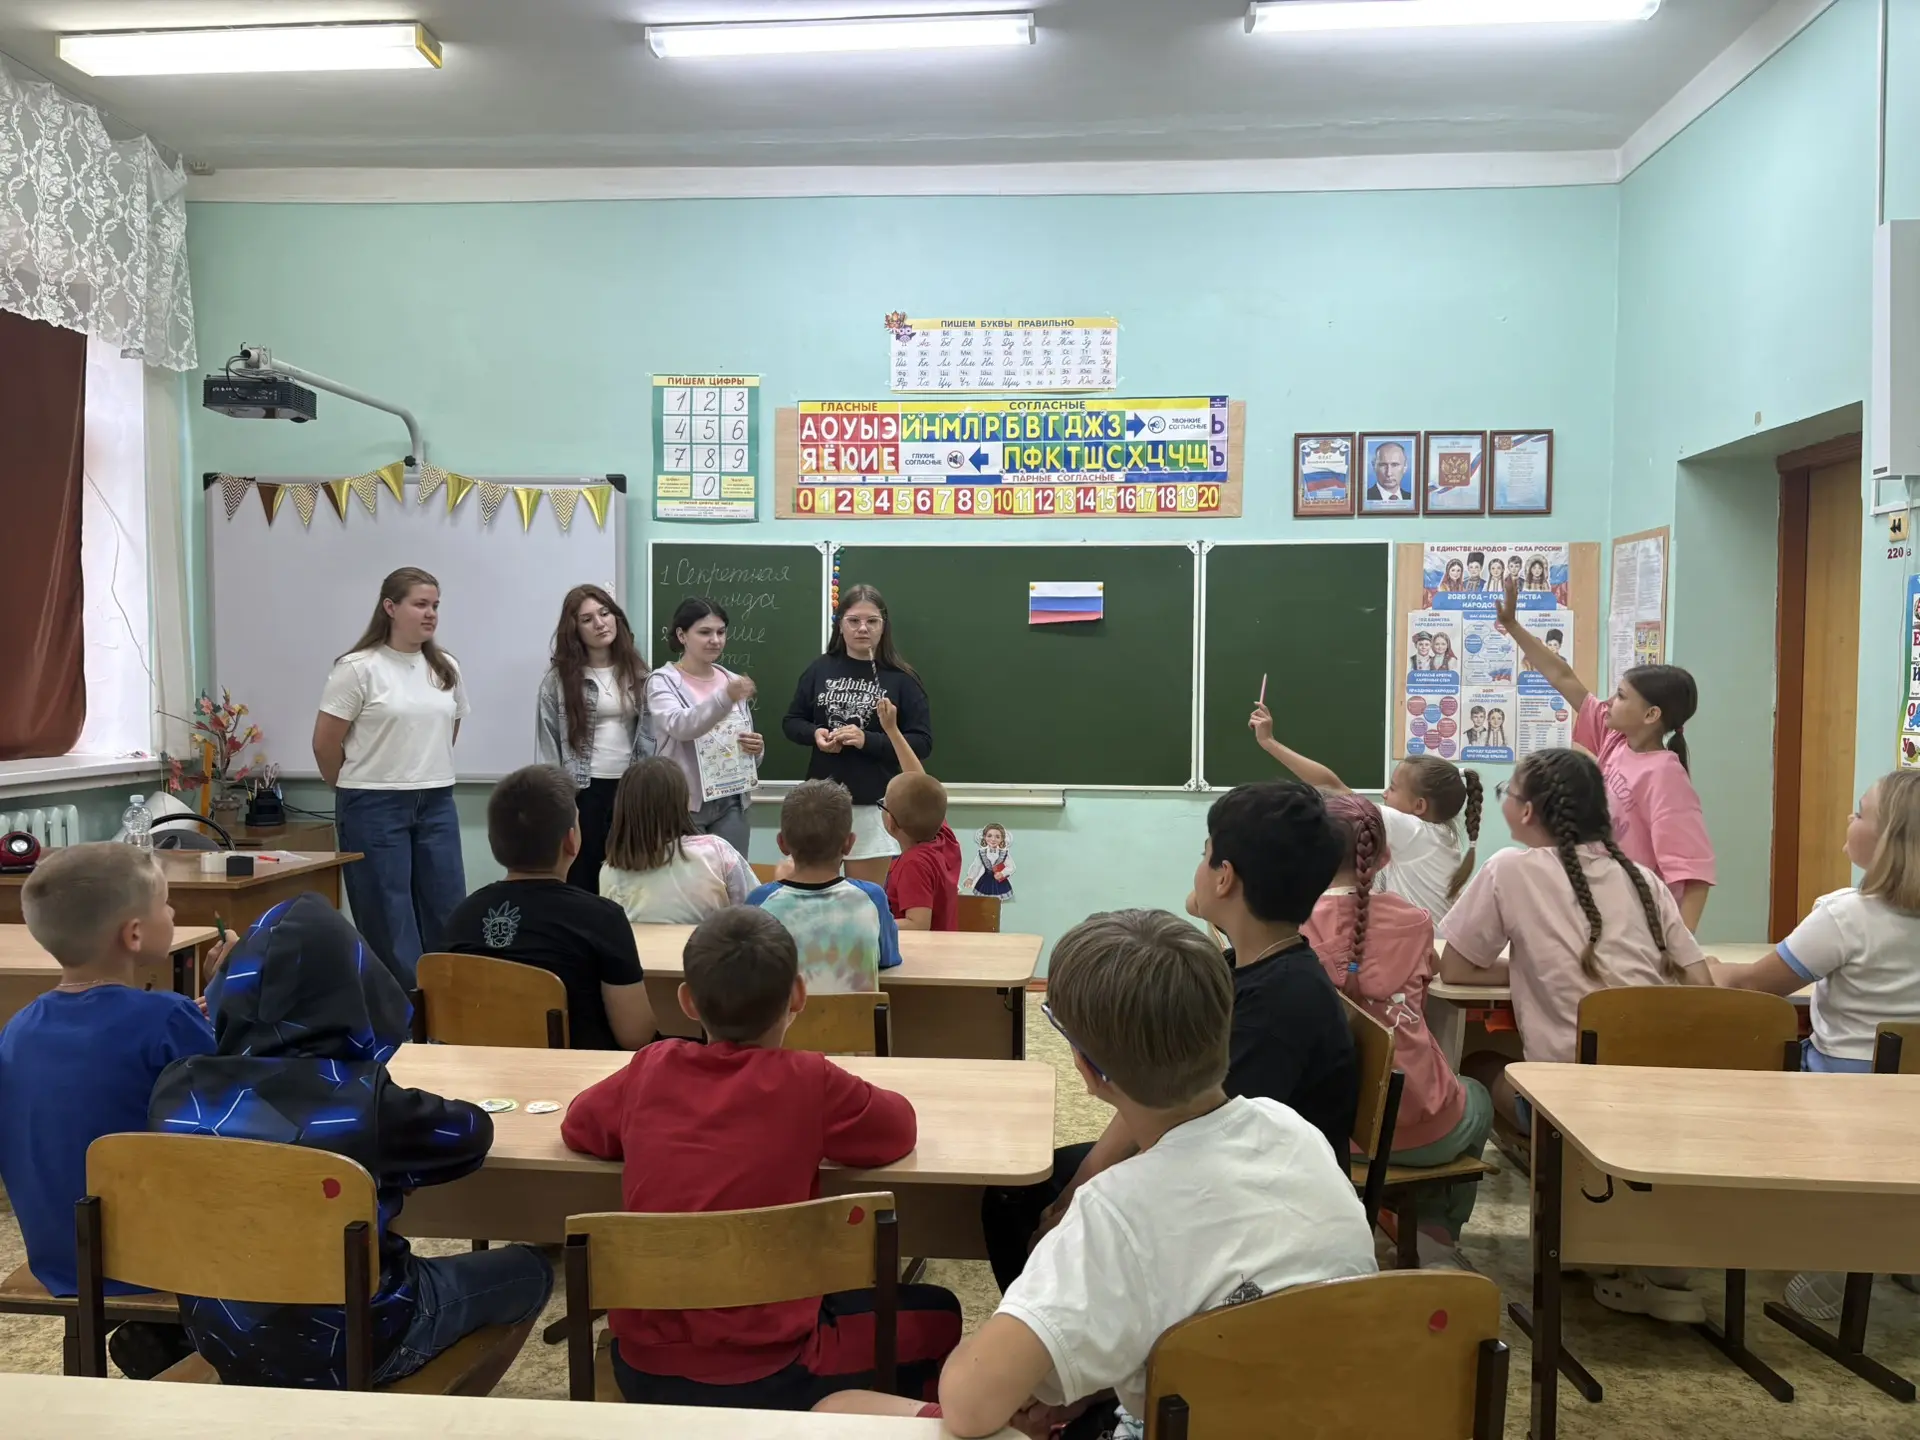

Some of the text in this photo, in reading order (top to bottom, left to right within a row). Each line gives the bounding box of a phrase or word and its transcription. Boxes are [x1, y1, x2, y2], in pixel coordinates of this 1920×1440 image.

[710, 378, 745, 386] ЦИФРЫ
[677, 392, 745, 411] 1 2 3
[821, 402, 878, 411] ГЛАСНЫЕ
[1009, 401, 1086, 410] СОГЛАСНЫЕ
[675, 419, 744, 440] 4 5 6
[1212, 414, 1224, 434] Ь
[675, 448, 744, 468] 7 8 9
[1210, 446, 1224, 466] Ъ
[703, 476, 716, 496] 0
[800, 486, 1219, 511] 0 1 2 3 4 5 6 7 8 9 10 11 12 13 14 15 16 17 18 19 20
[1887, 547, 1904, 559] 220
[660, 558, 792, 596] 1 Секретная
[661, 627, 669, 641] 2
